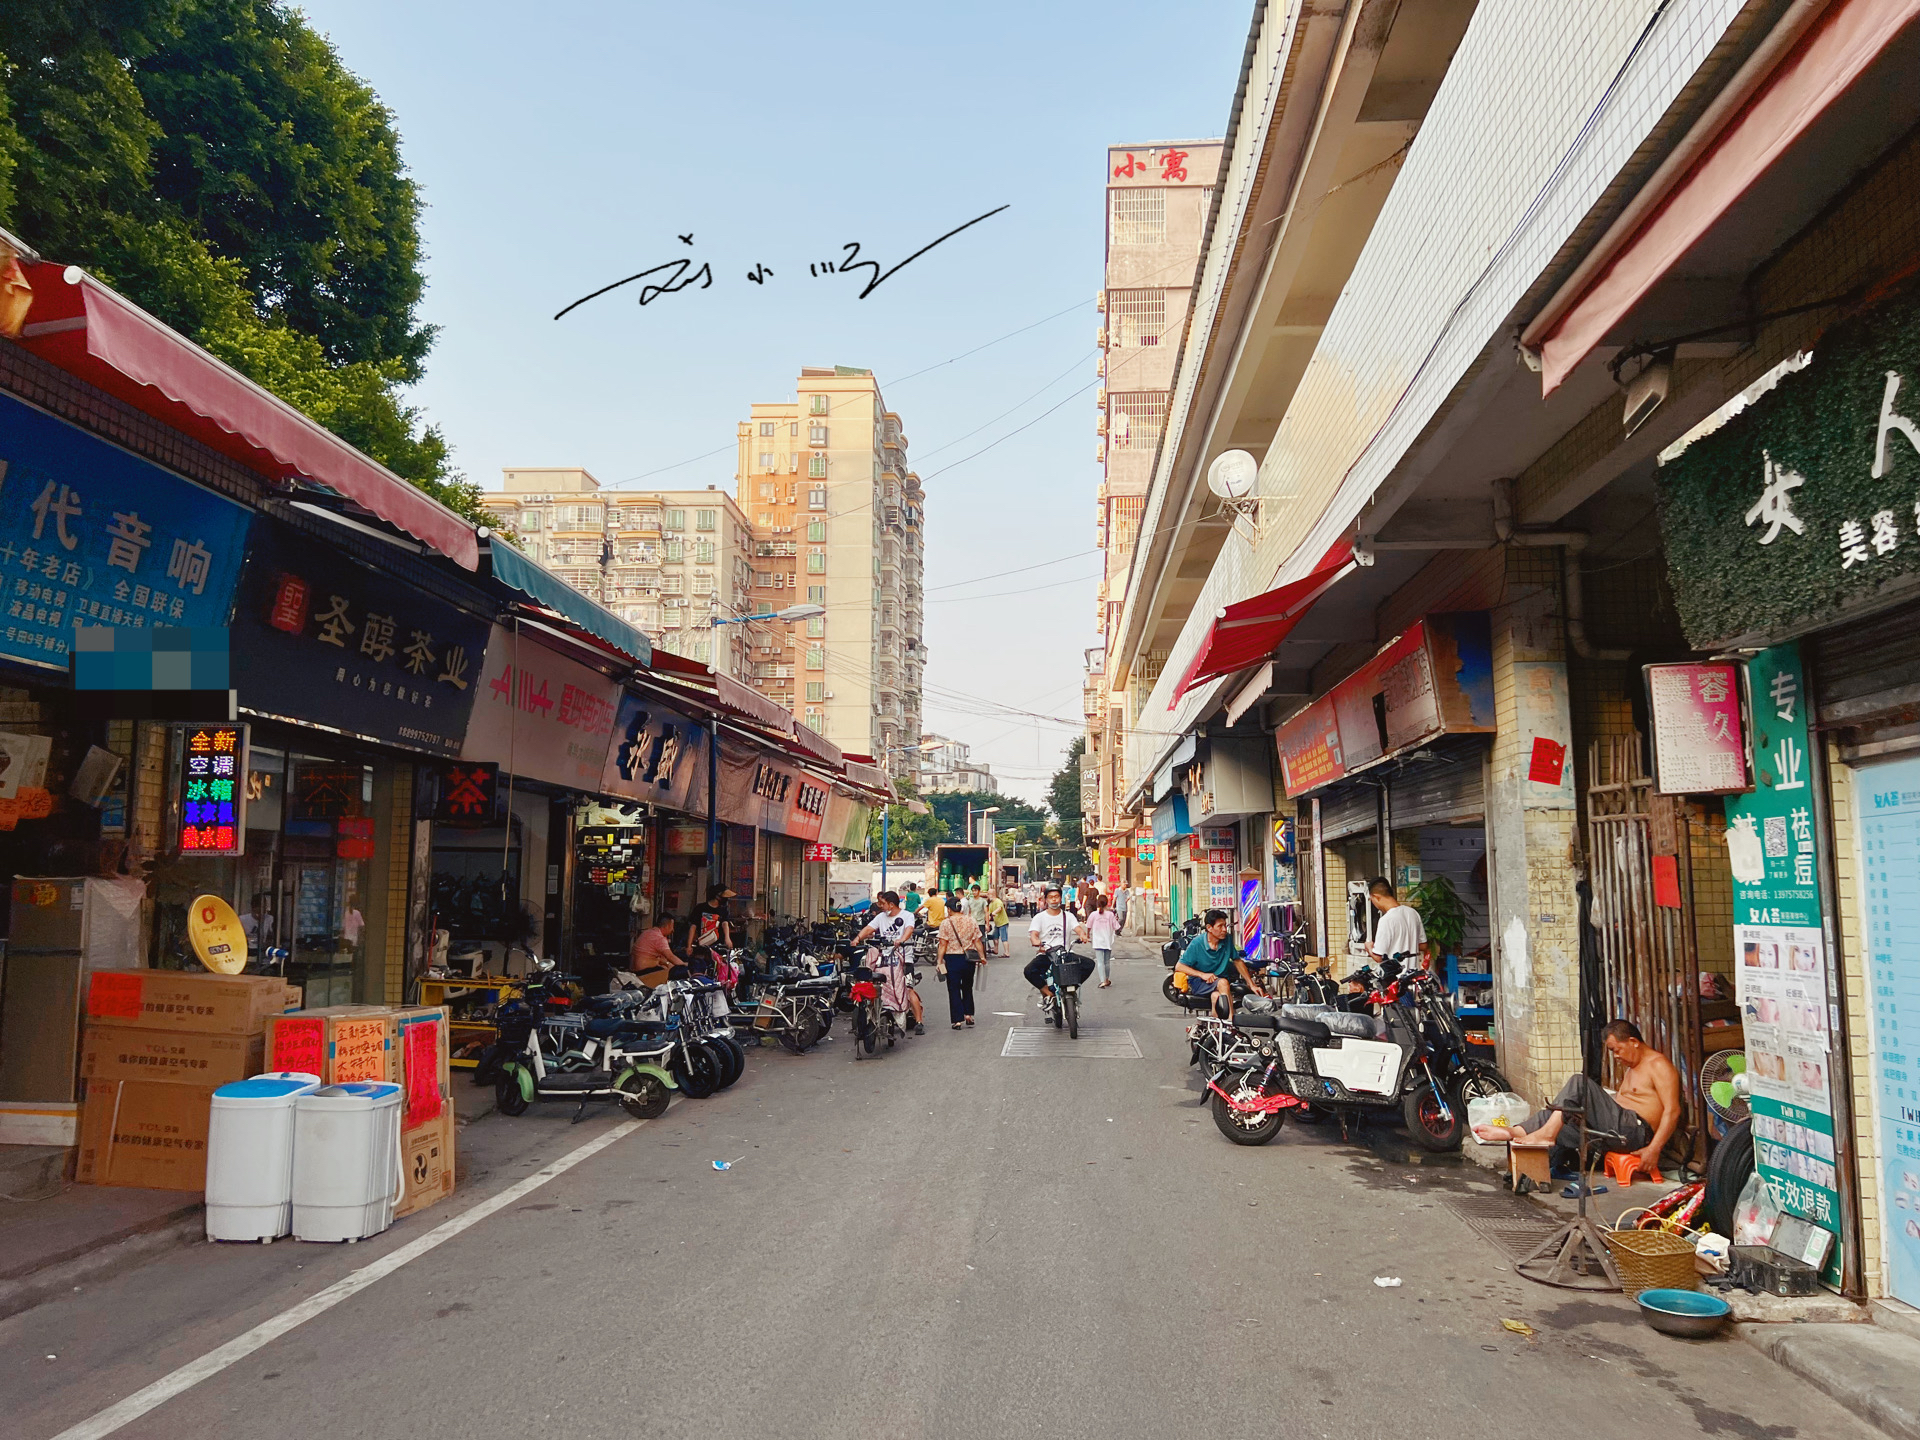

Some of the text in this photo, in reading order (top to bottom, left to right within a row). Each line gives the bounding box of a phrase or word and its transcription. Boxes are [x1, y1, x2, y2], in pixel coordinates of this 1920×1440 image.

[1114, 148, 1188, 182] 小寓
[0, 460, 213, 595] 代音响
[1838, 500, 1920, 569] 美容
[113, 579, 185, 619] 全国联保
[314, 594, 468, 691] 圣醇茶业
[190, 731, 236, 752] 全新
[1770, 671, 1804, 791] 专业
[189, 755, 234, 775] 空调
[187, 779, 234, 800] 冰箱
[441, 766, 490, 816] 茶
[668, 829, 703, 852] 修车
[805, 845, 832, 861] 学车
[1211, 851, 1233, 862] 照相
[1211, 864, 1233, 873] 发光字
[1211, 886, 1233, 895] 复印打印
[1211, 897, 1233, 907] 名片刻章
[145, 1044, 167, 1053] TCL
[139, 1123, 161, 1132] TCL
[1769, 1175, 1832, 1224] 无效退款
